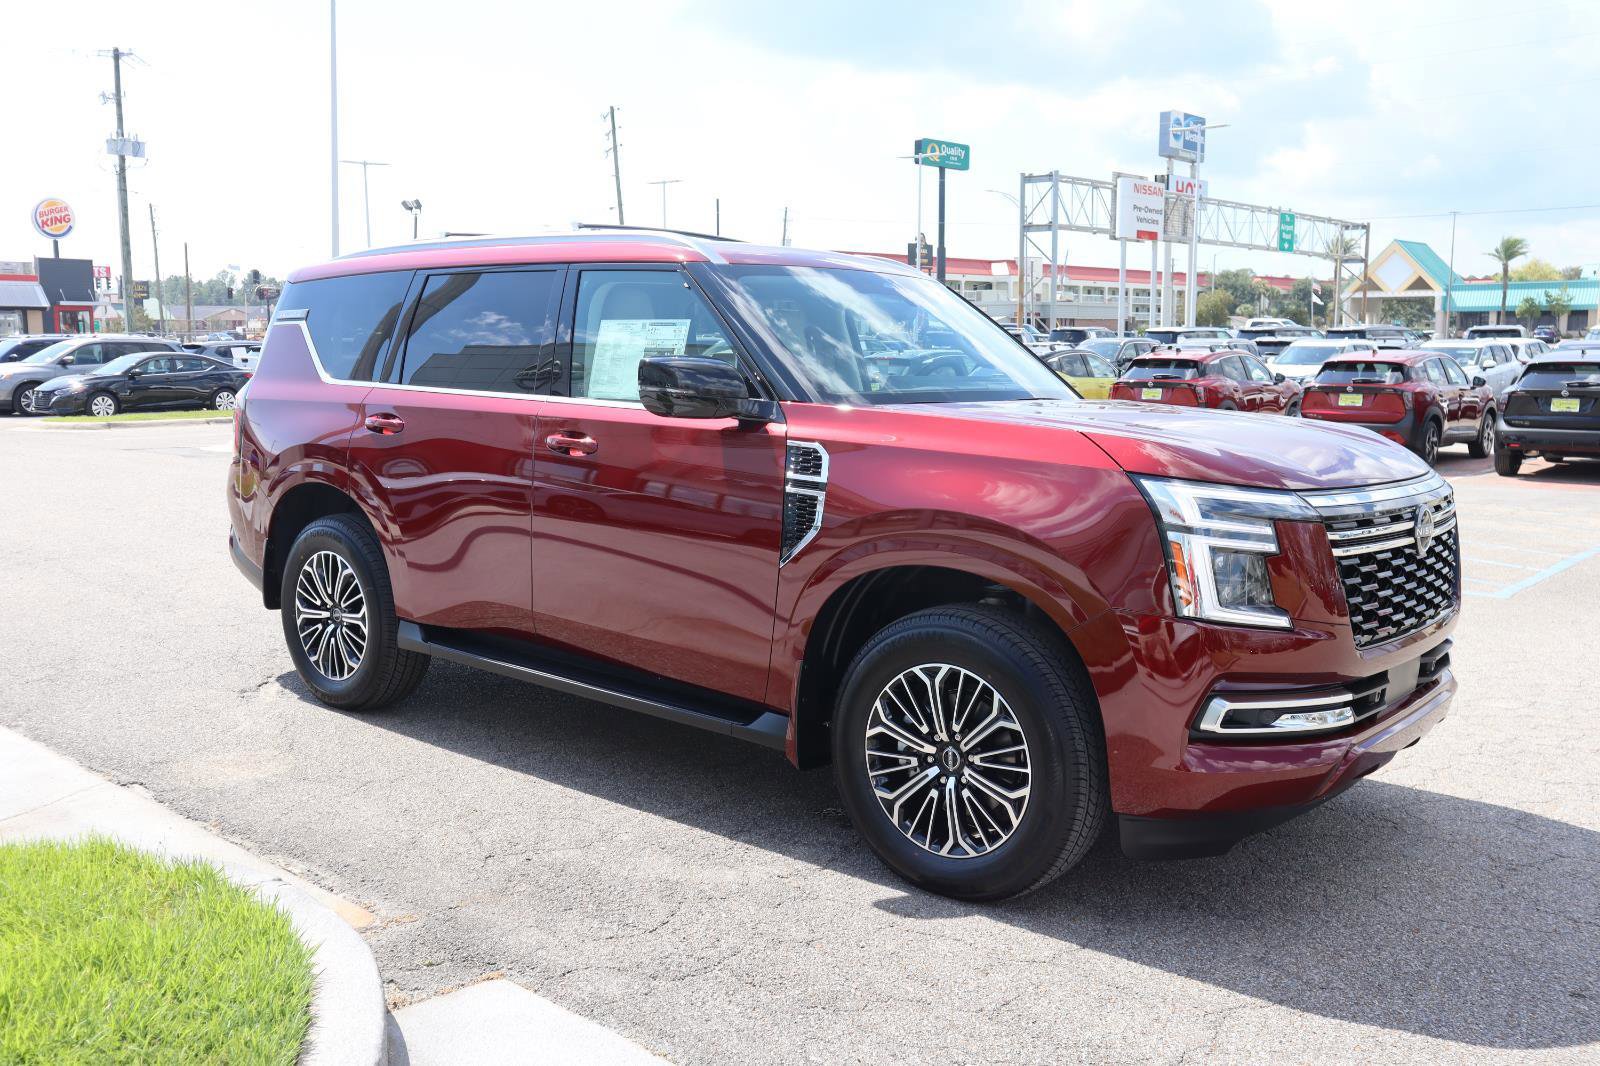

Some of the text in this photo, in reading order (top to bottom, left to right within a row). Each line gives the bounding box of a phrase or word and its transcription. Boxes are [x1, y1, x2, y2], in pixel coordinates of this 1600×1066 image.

[941, 144, 966, 159] Quality
[1133, 183, 1164, 197] NISSAN
[38, 206, 69, 219] BURGER
[1133, 204, 1163, 215] Pre-Owned
[41, 213, 72, 228] KING
[1136, 216, 1159, 225] Vehicles
